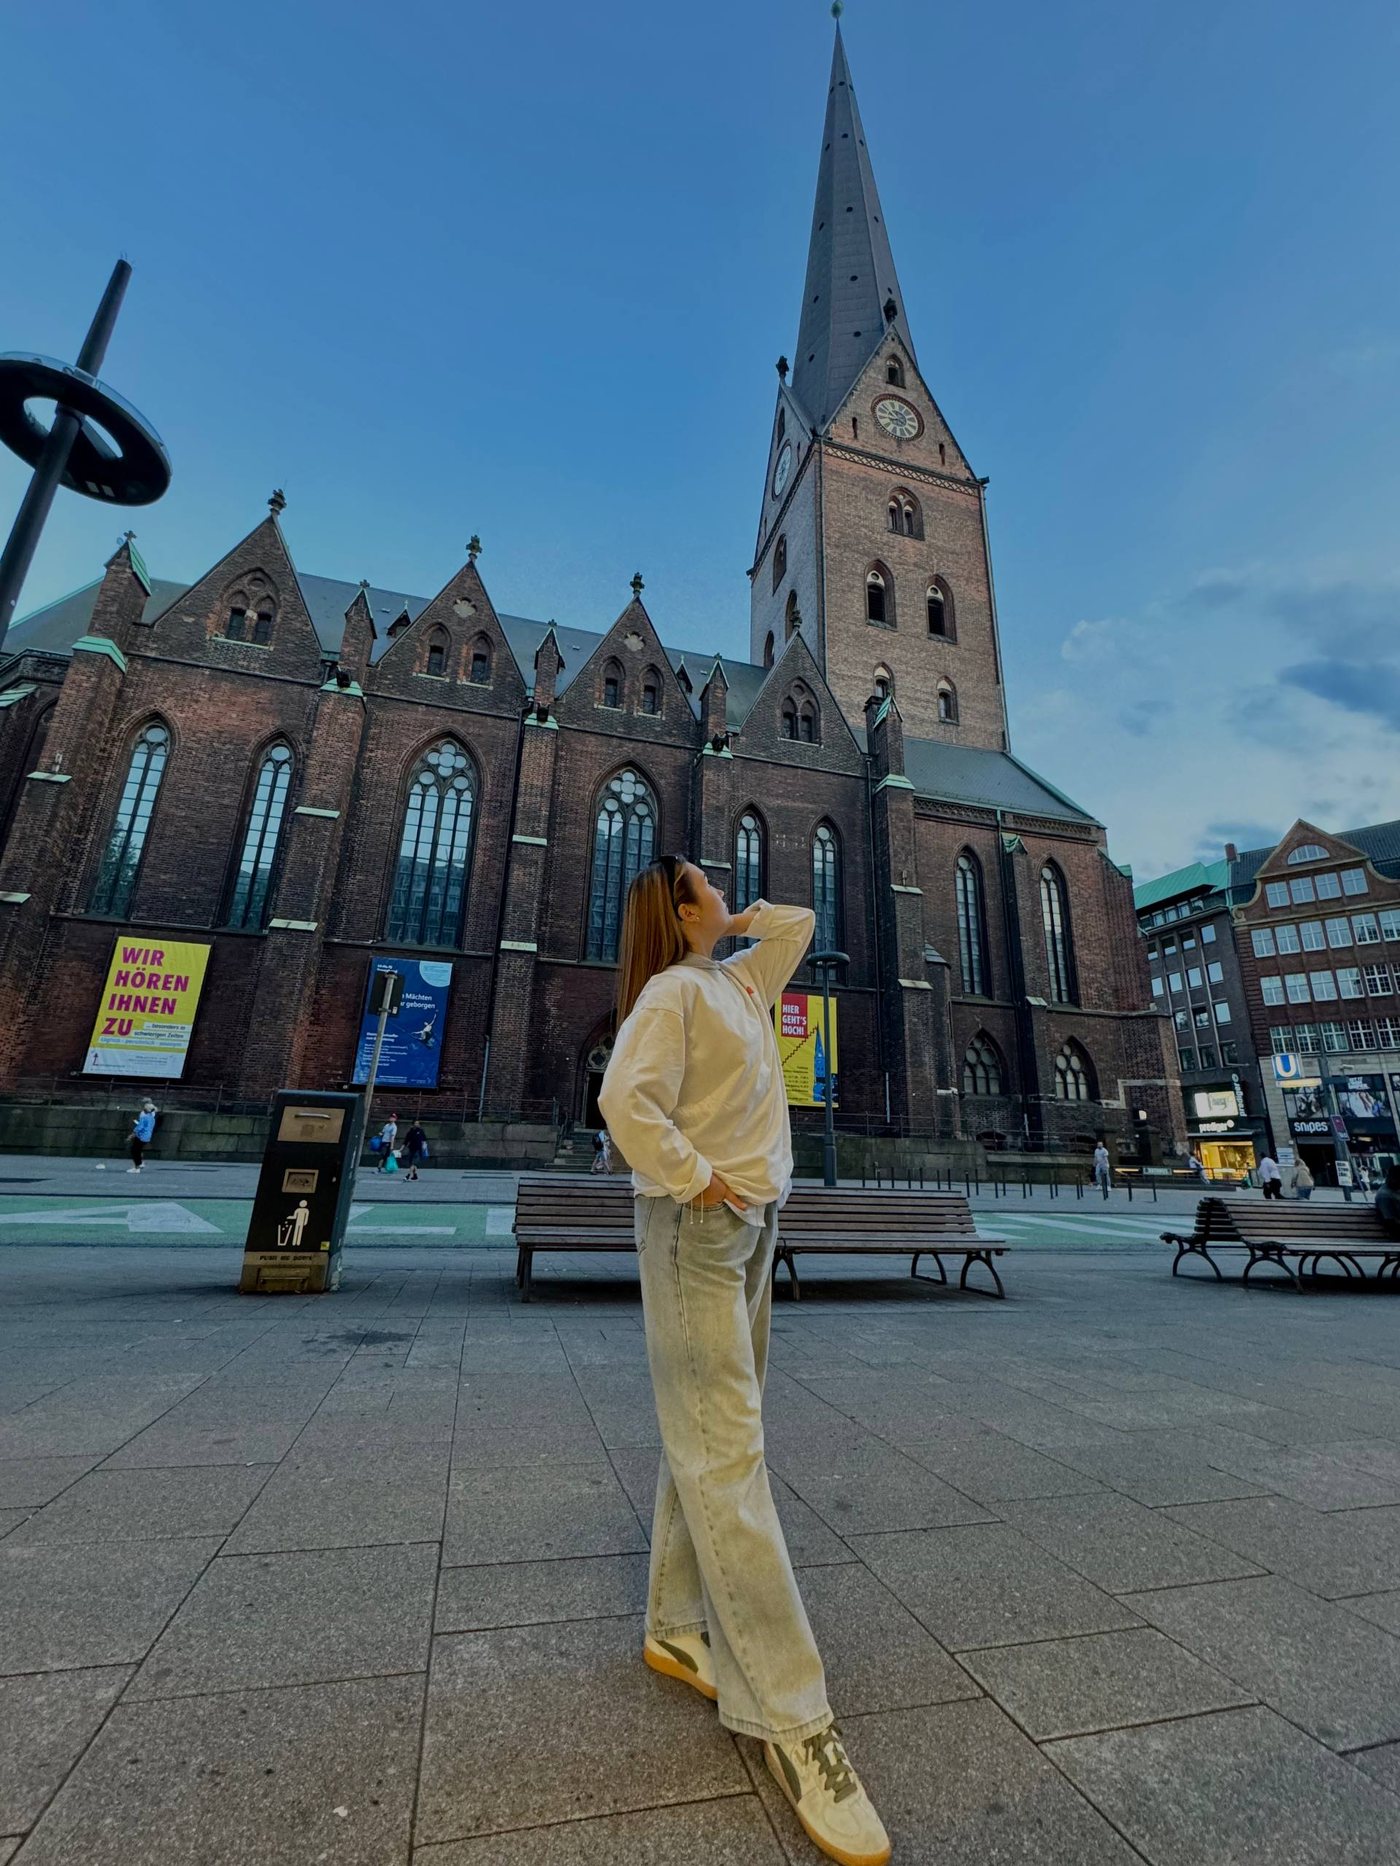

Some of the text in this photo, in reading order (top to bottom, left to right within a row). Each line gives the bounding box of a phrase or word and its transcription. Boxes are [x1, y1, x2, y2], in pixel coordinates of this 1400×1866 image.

[122, 947, 165, 967] WIR
[114, 967, 190, 992] HÖREN
[405, 993, 432, 1001] Mächten
[108, 993, 178, 1015] IHNEN
[405, 1002, 436, 1010] geborgen
[782, 1004, 800, 1014] HIER
[782, 1015, 807, 1025] GEHT'S
[101, 1017, 134, 1036] ZU
[782, 1025, 805, 1035] HOCH!
[1275, 1055, 1297, 1077] U
[1294, 1121, 1328, 1133] snipes
